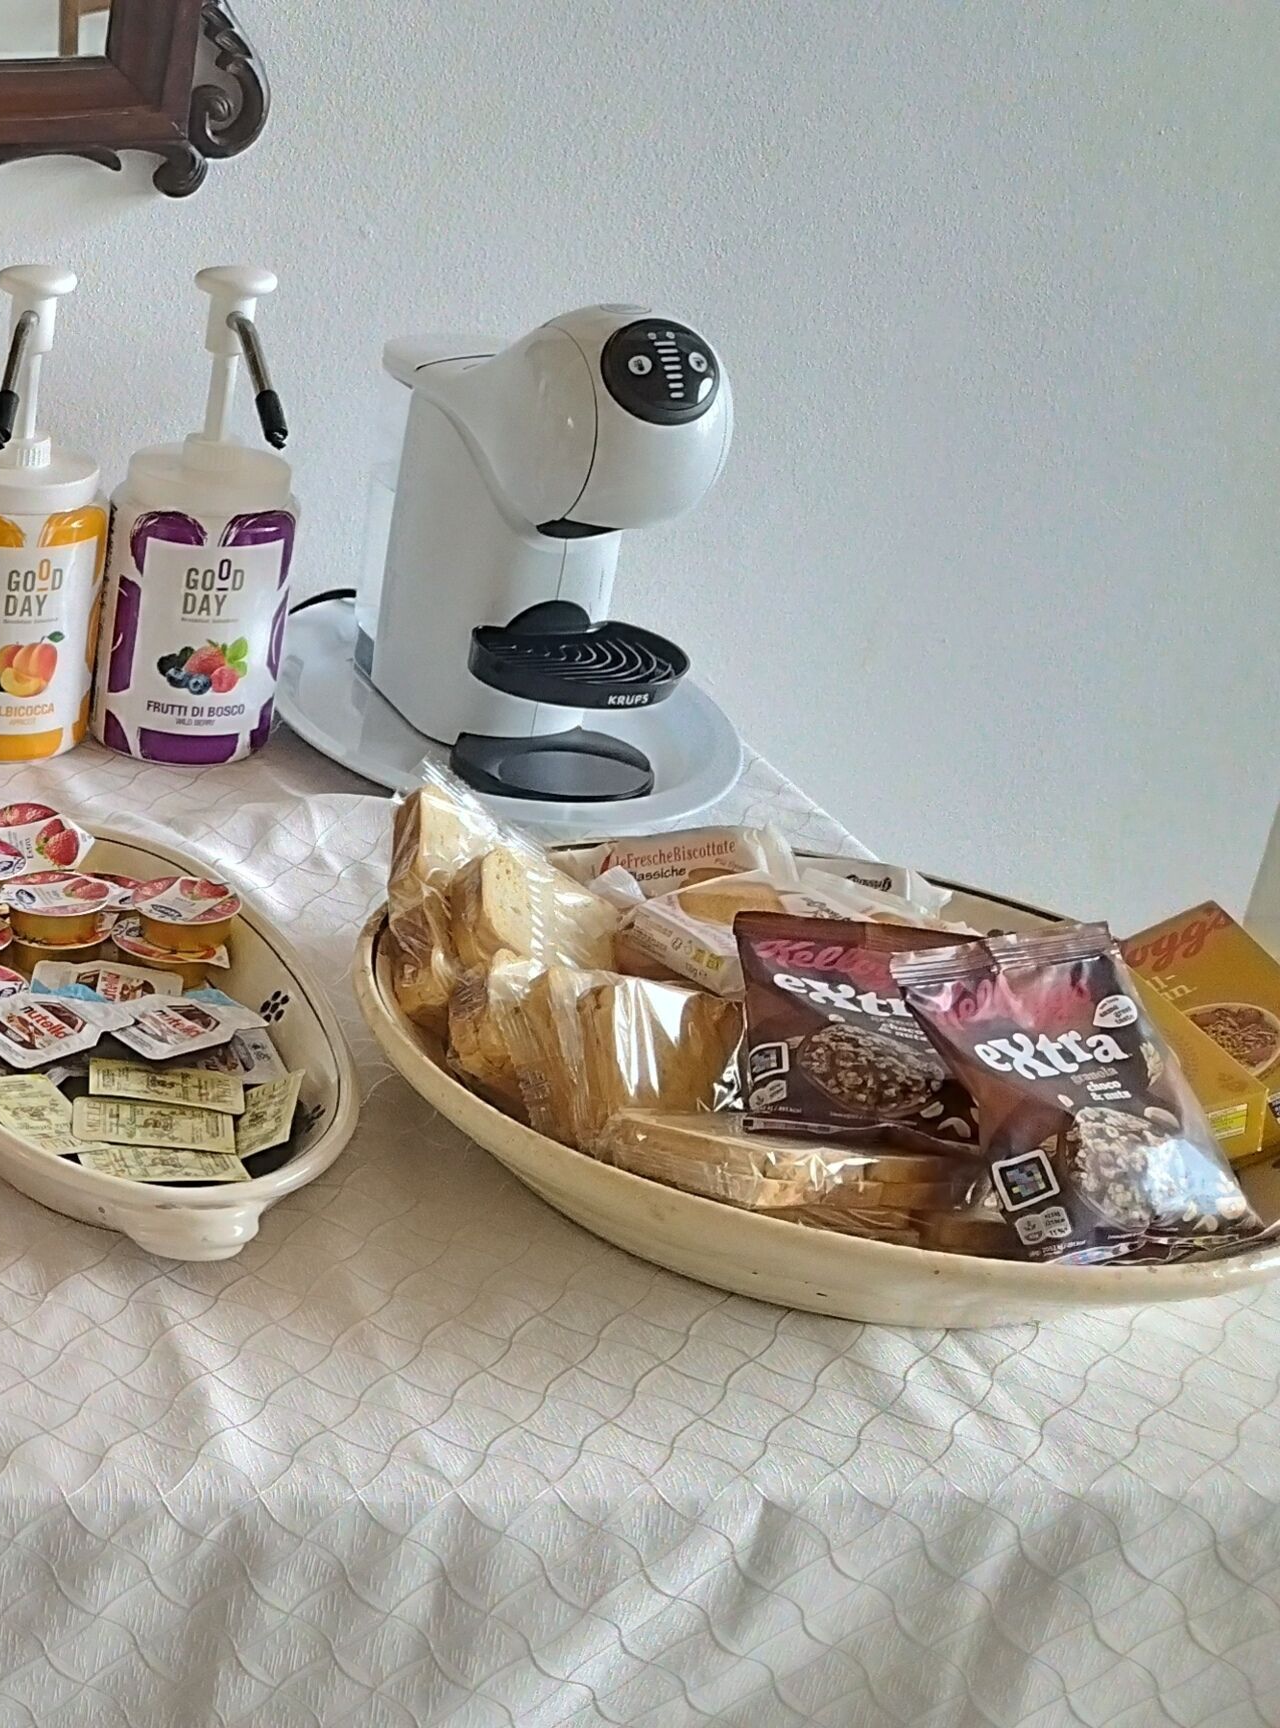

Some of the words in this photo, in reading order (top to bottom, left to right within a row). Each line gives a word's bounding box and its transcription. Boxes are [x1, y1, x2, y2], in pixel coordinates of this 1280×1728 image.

[6, 558, 64, 593] GOOD
[185, 558, 245, 592] GOOD
[3, 594, 48, 617] DAY
[182, 592, 227, 617] DAY
[146, 700, 188, 717] FRUTTI
[191, 704, 204, 718] DI
[207, 704, 246, 718] BOSCO
[608, 693, 649, 706] KRUPS
[1125, 906, 1235, 973] ogg's
[773, 973, 914, 1018] extr
[19, 1005, 68, 1040] nutella
[154, 1008, 203, 1039] nutella
[1070, 1065, 1119, 1086] granola
[1086, 1080, 1122, 1093] choco
[1090, 1091, 1104, 1102] &
[1105, 1089, 1132, 1101] nuts
